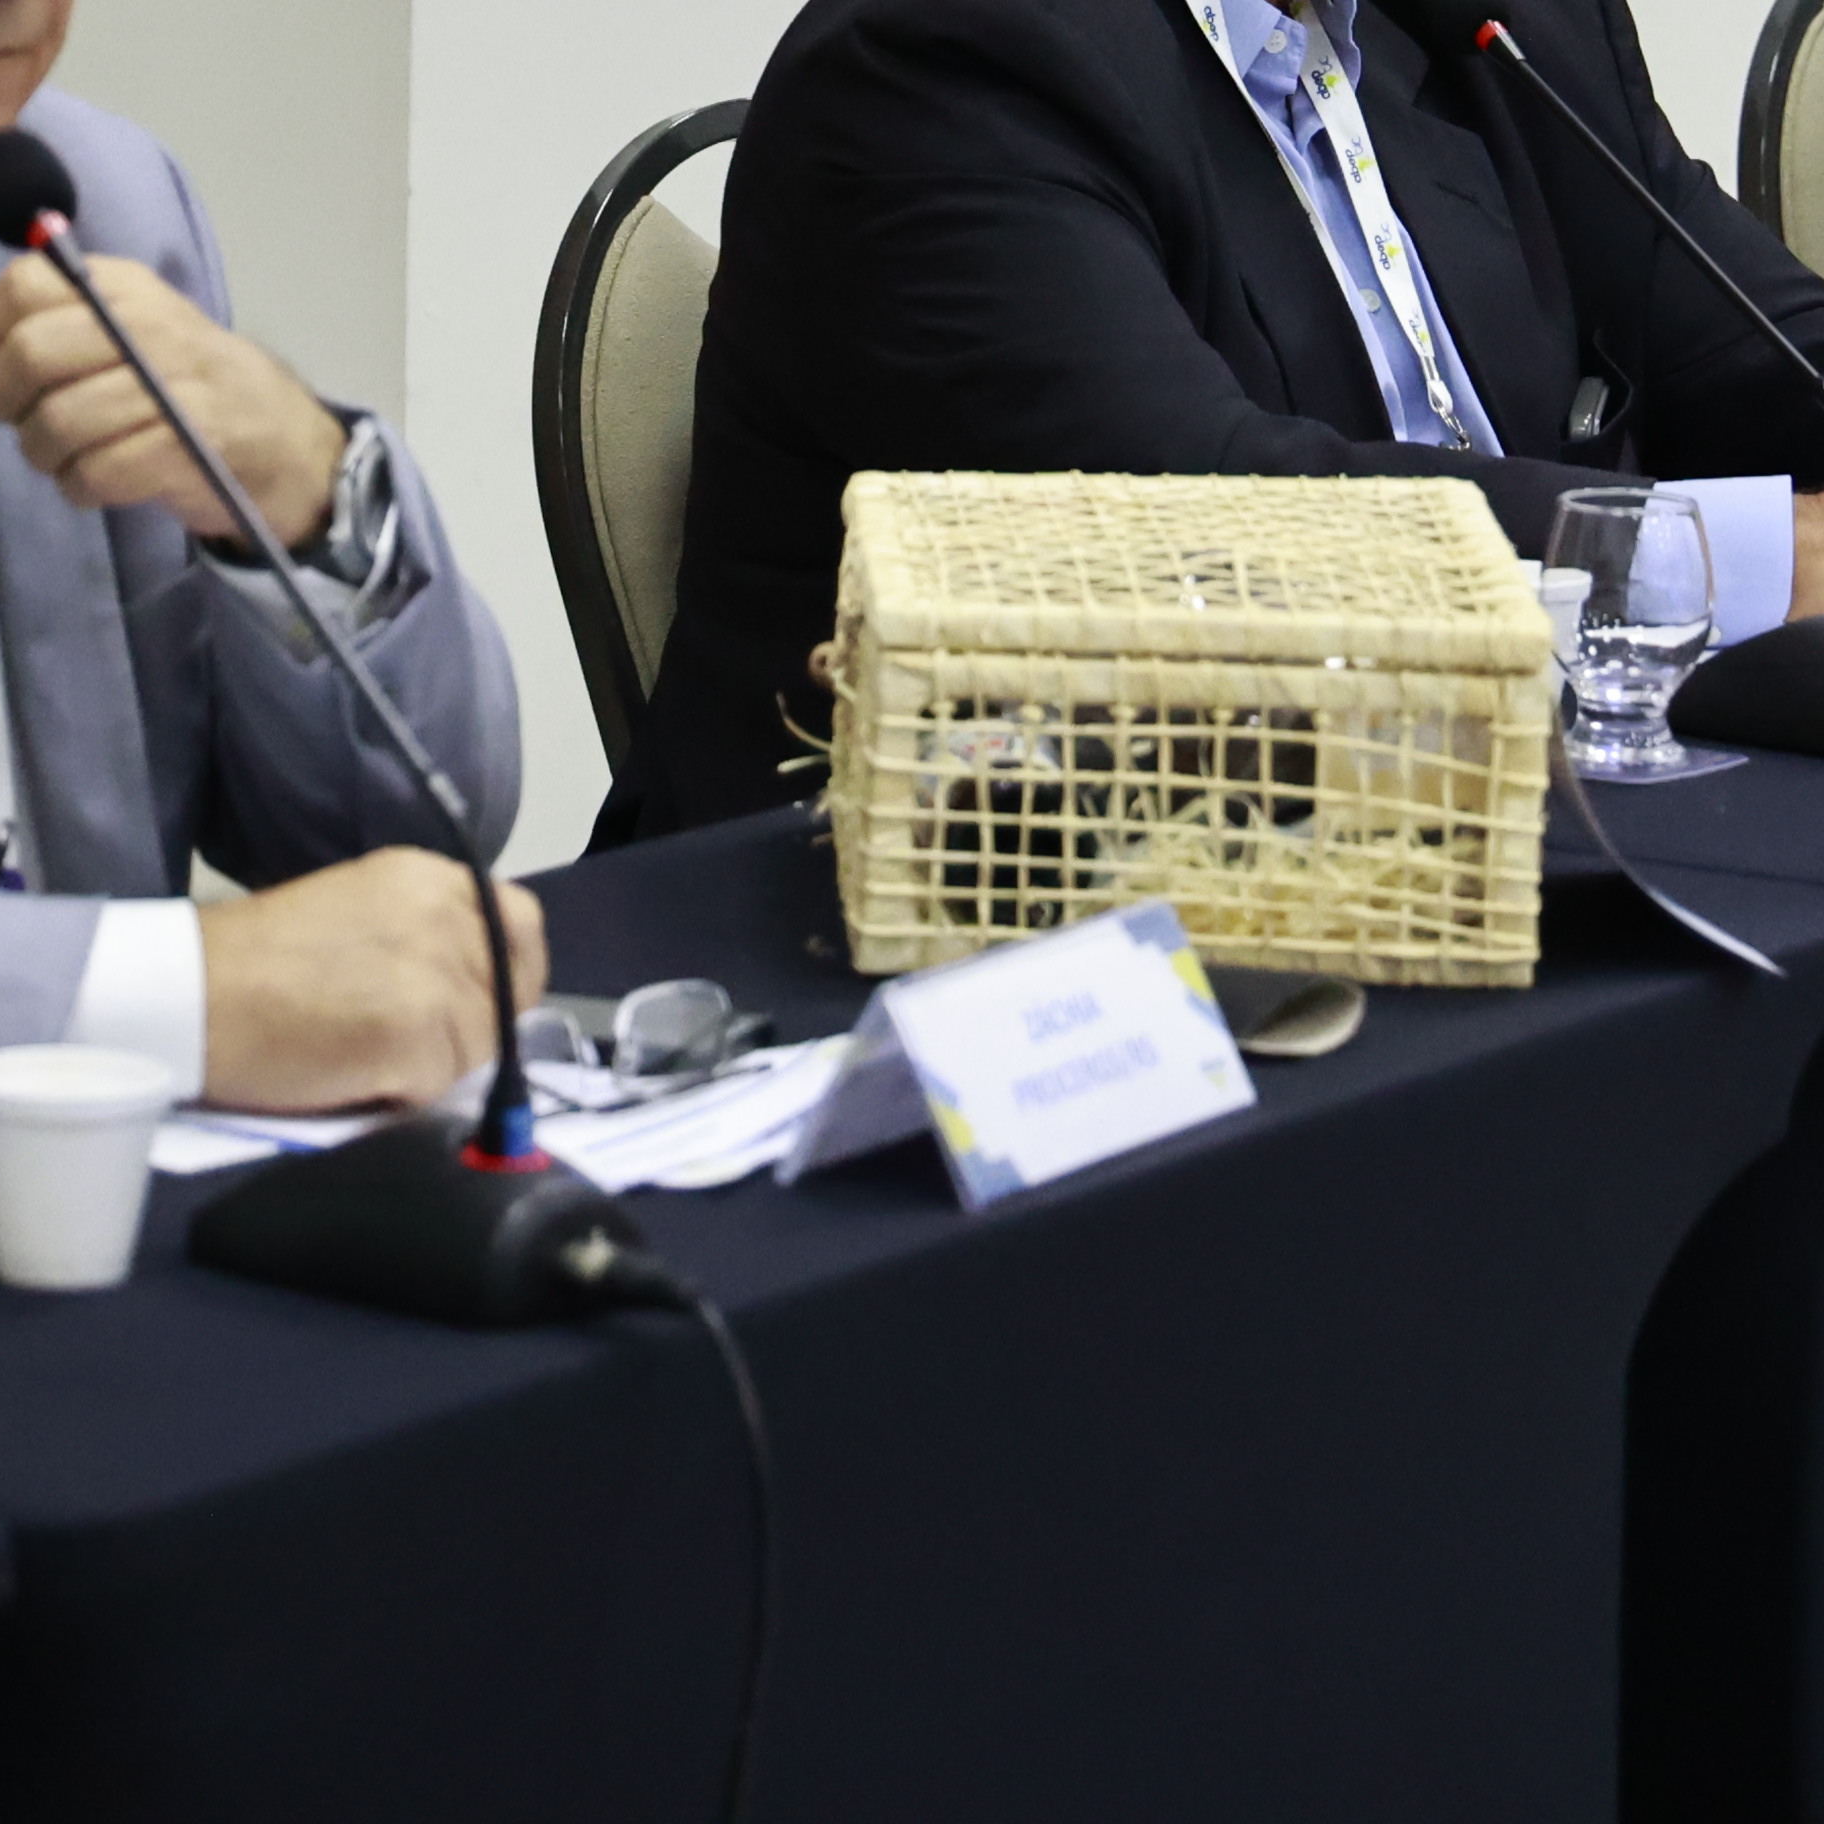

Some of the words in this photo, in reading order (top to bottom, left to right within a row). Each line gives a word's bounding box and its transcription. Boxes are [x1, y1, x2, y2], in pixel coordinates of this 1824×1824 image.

[1204, 6, 1219, 41] abep
[1311, 70, 1331, 99] abep
[1345, 149, 1362, 183] abep
[1374, 235, 1391, 270] abep
